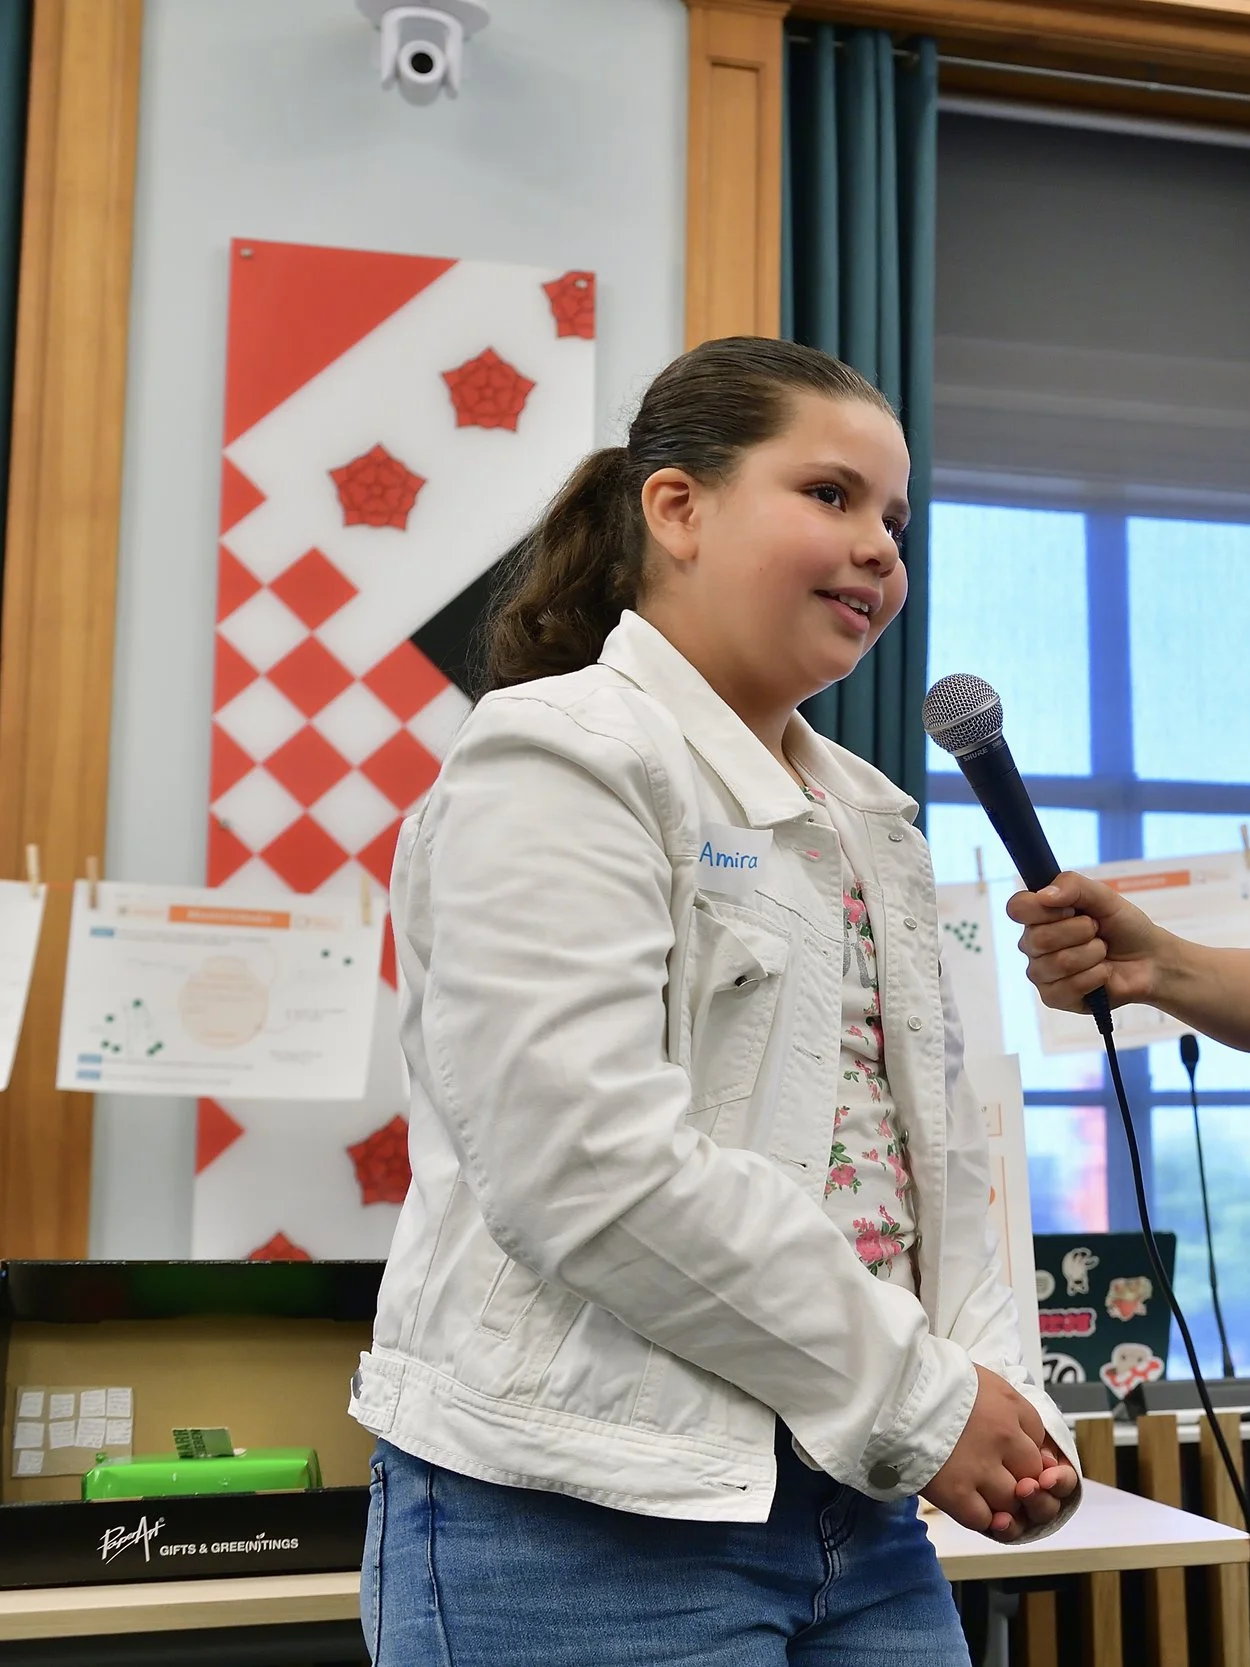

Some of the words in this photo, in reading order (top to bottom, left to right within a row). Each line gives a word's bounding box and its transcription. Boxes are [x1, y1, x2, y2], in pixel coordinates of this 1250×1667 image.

[699, 841, 758, 869] Amira
[159, 1543, 196, 1557] GIFTS
[199, 1543, 208, 1554] &
[211, 1537, 299, 1554] GREE(N)TINGS
